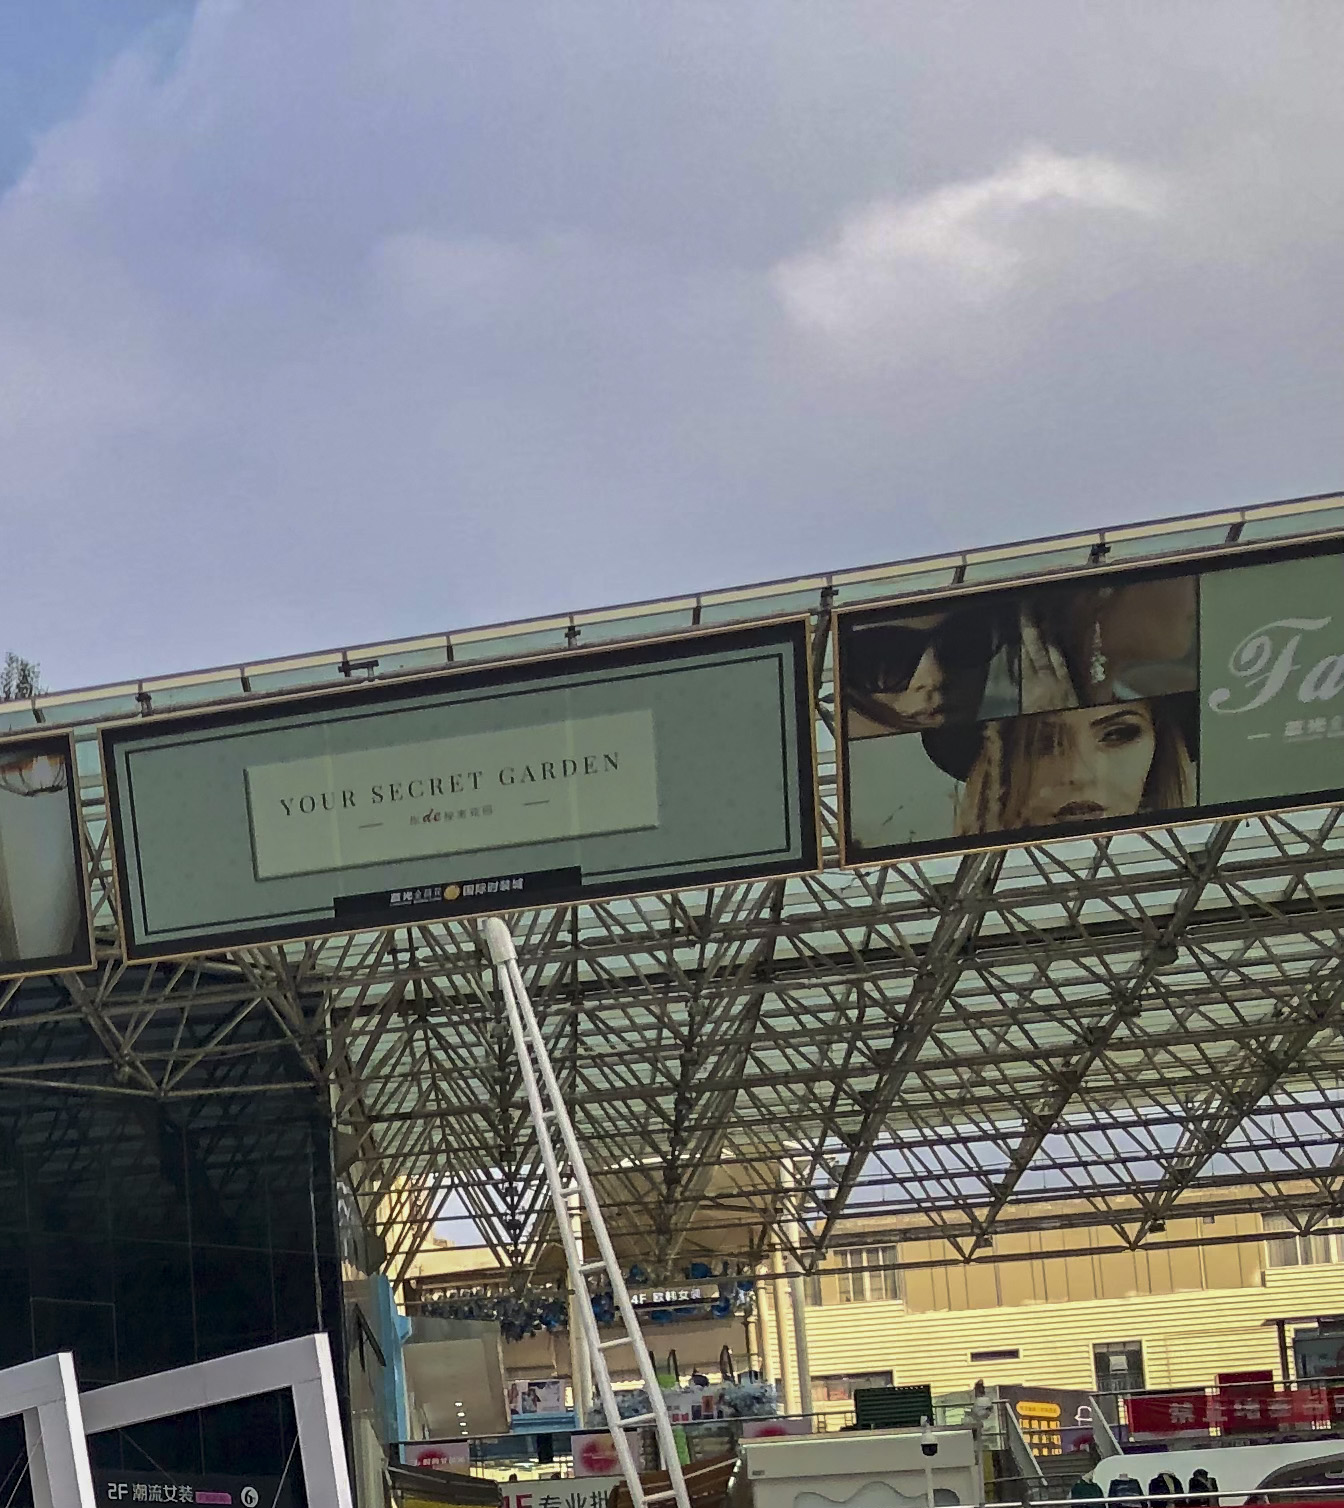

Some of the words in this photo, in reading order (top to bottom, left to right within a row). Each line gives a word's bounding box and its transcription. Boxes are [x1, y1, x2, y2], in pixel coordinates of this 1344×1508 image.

[278, 789, 359, 817] YOUR
[370, 770, 484, 806] SECRET
[498, 752, 622, 786] GARDEN
[108, 1483, 128, 1500] 2F
[132, 1484, 194, 1503] 潮流女装
